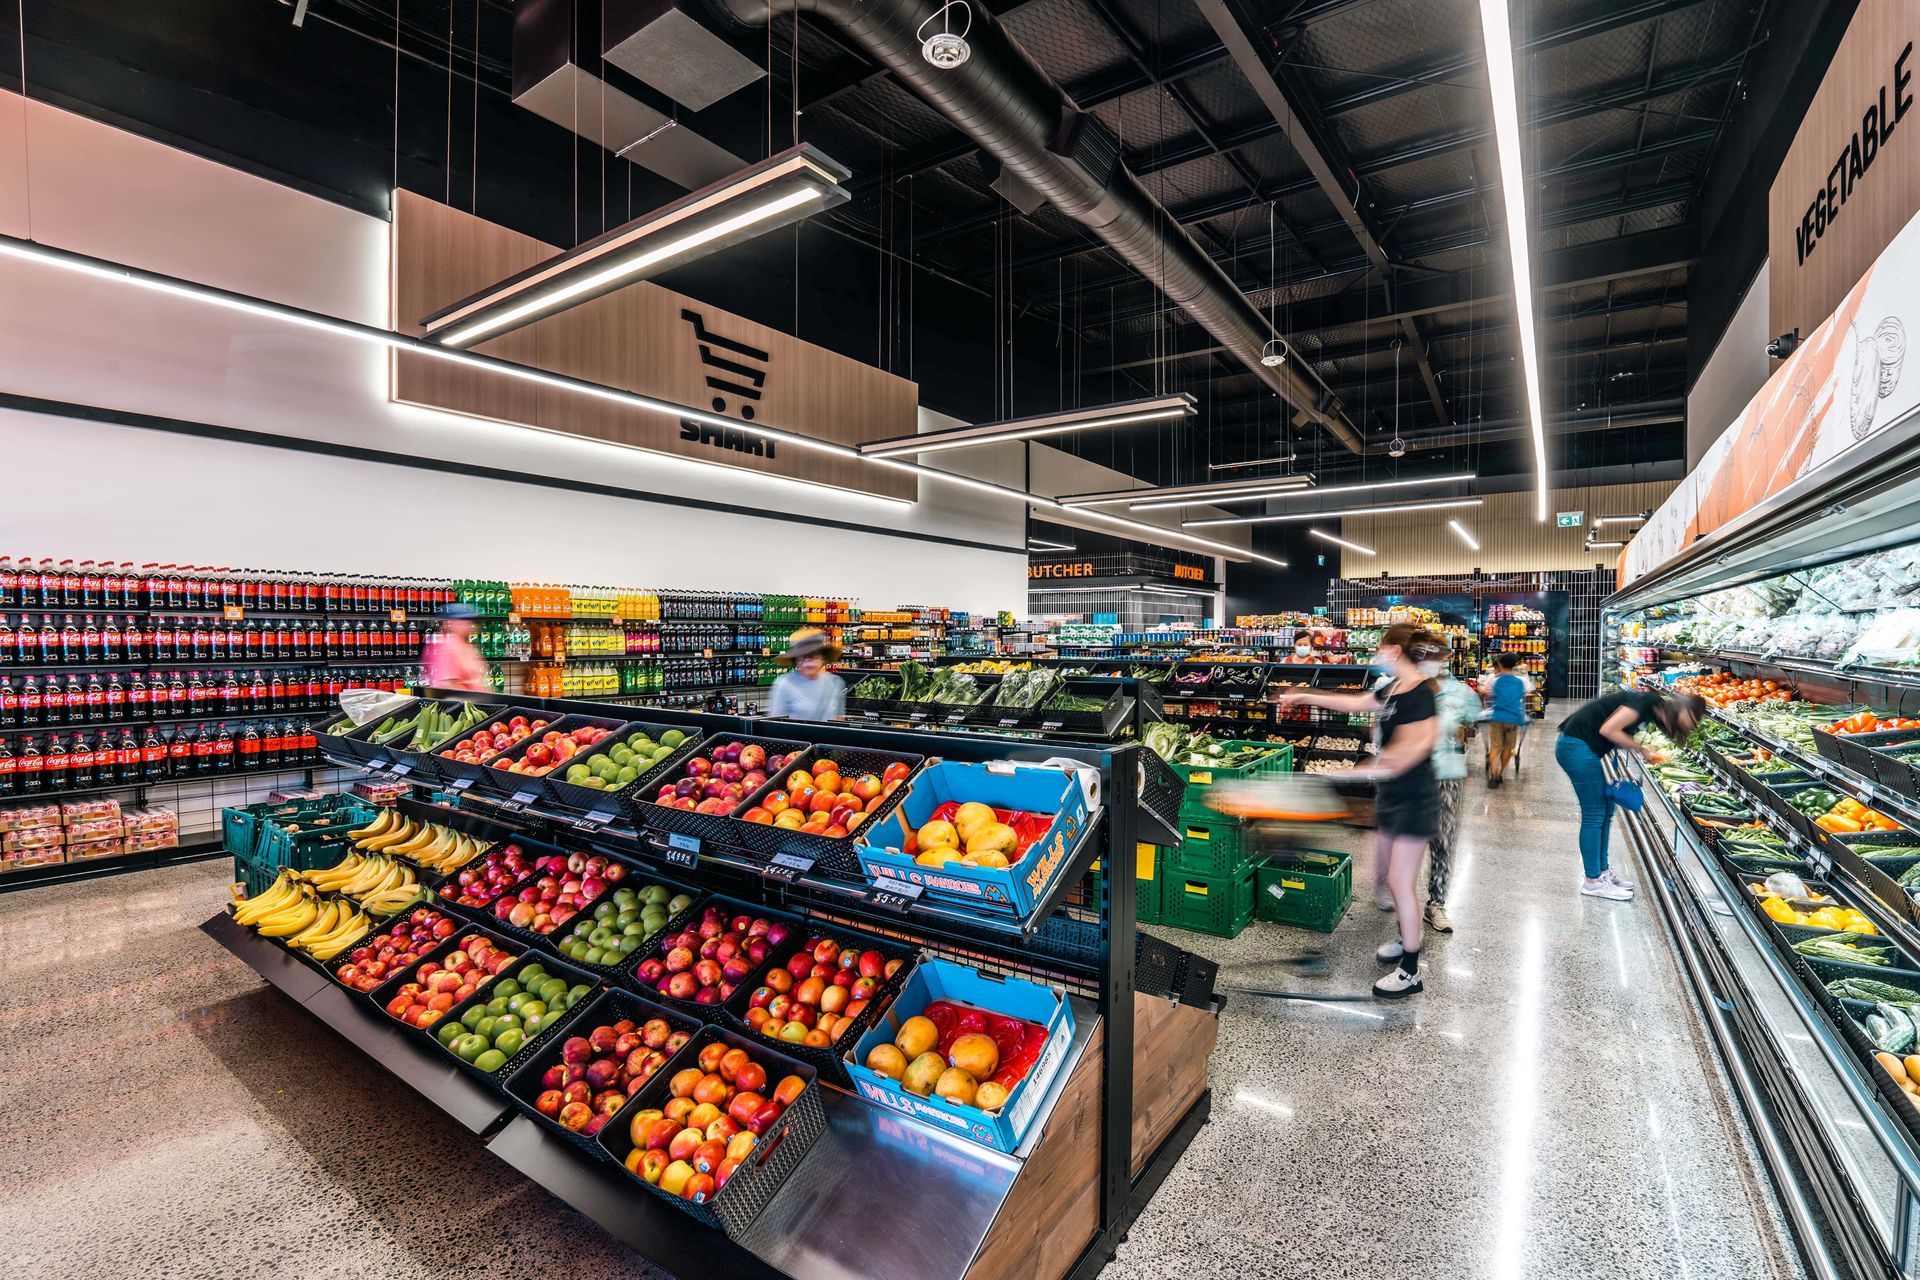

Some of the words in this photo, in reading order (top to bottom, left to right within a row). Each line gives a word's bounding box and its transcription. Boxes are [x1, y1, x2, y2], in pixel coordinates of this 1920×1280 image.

[1796, 41, 1912, 266] VEGETABLE
[680, 416, 779, 459] SMART
[1028, 563, 1093, 579] BUTCHER
[1174, 564, 1204, 581] BUTCHER
